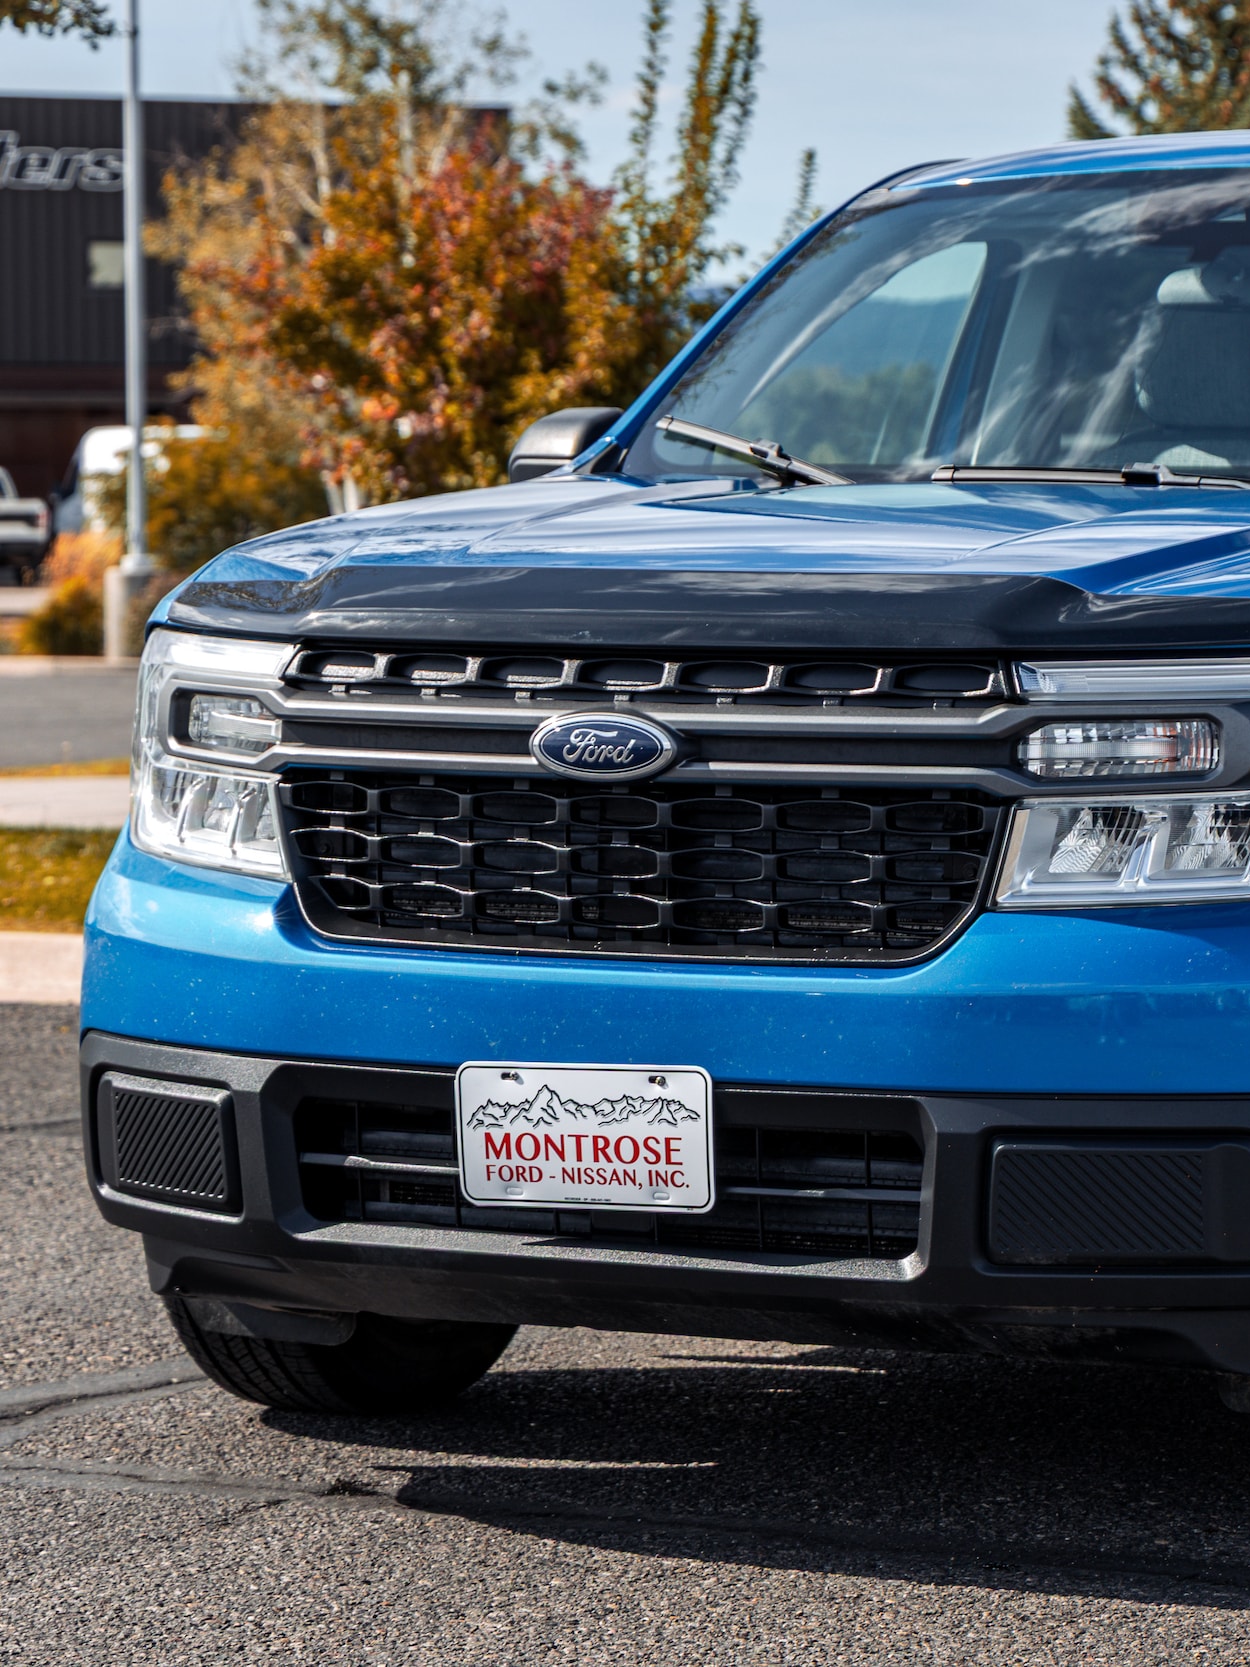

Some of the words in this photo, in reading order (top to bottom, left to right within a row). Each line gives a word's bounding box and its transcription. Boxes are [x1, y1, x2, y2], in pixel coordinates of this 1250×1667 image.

[563, 728, 636, 764] Ford
[484, 1132, 683, 1166] MONTROSE
[485, 1164, 543, 1183] FORD
[562, 1167, 643, 1190] NISSAN,
[648, 1169, 690, 1188] INC.
